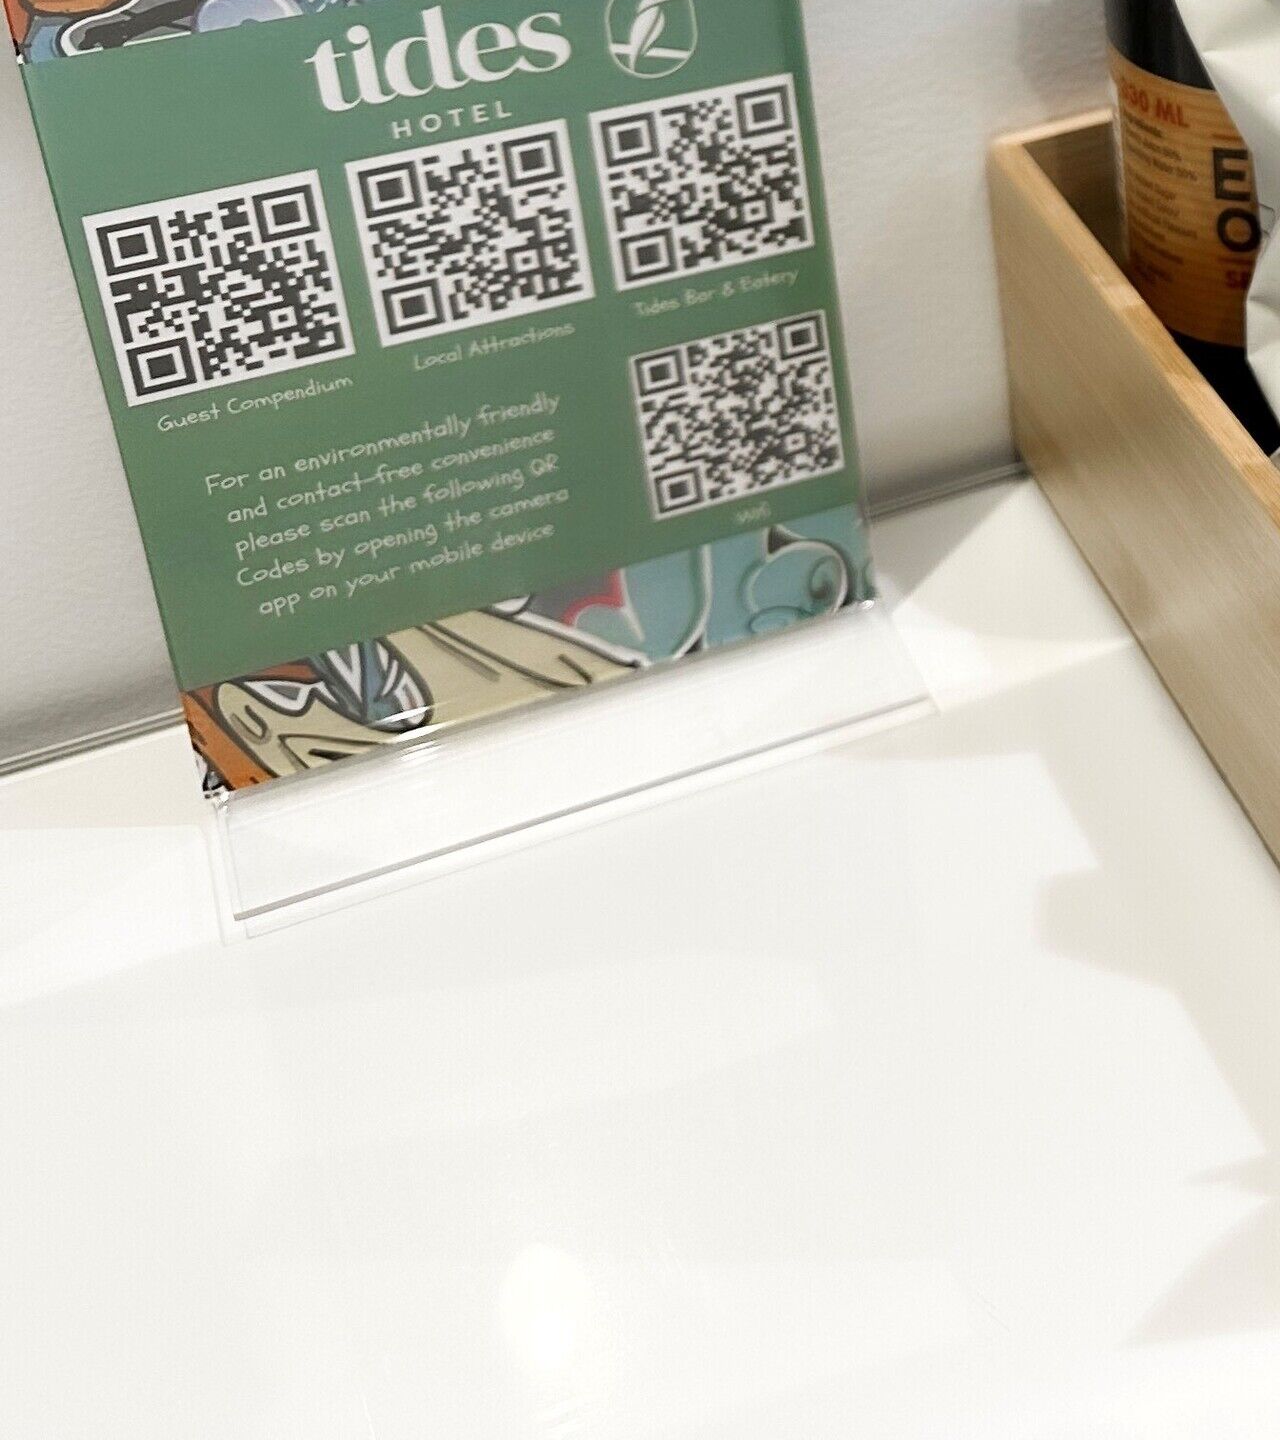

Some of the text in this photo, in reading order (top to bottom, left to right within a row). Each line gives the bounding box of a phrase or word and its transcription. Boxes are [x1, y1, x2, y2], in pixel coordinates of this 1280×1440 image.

[304, 4, 572, 112] tides
[391, 100, 513, 140] HOTEL
[633, 268, 801, 318] Tides Bar & Eatery
[411, 321, 576, 372] Local Attractions
[157, 376, 354, 432] Guest Compendium
[206, 390, 560, 496] For an environmentally friendly
[227, 428, 556, 524] and contact-free convenience
[235, 453, 560, 561] please scan the following QR
[236, 488, 570, 587] Codes by opening the camera
[258, 523, 556, 618] app on your mobile device
